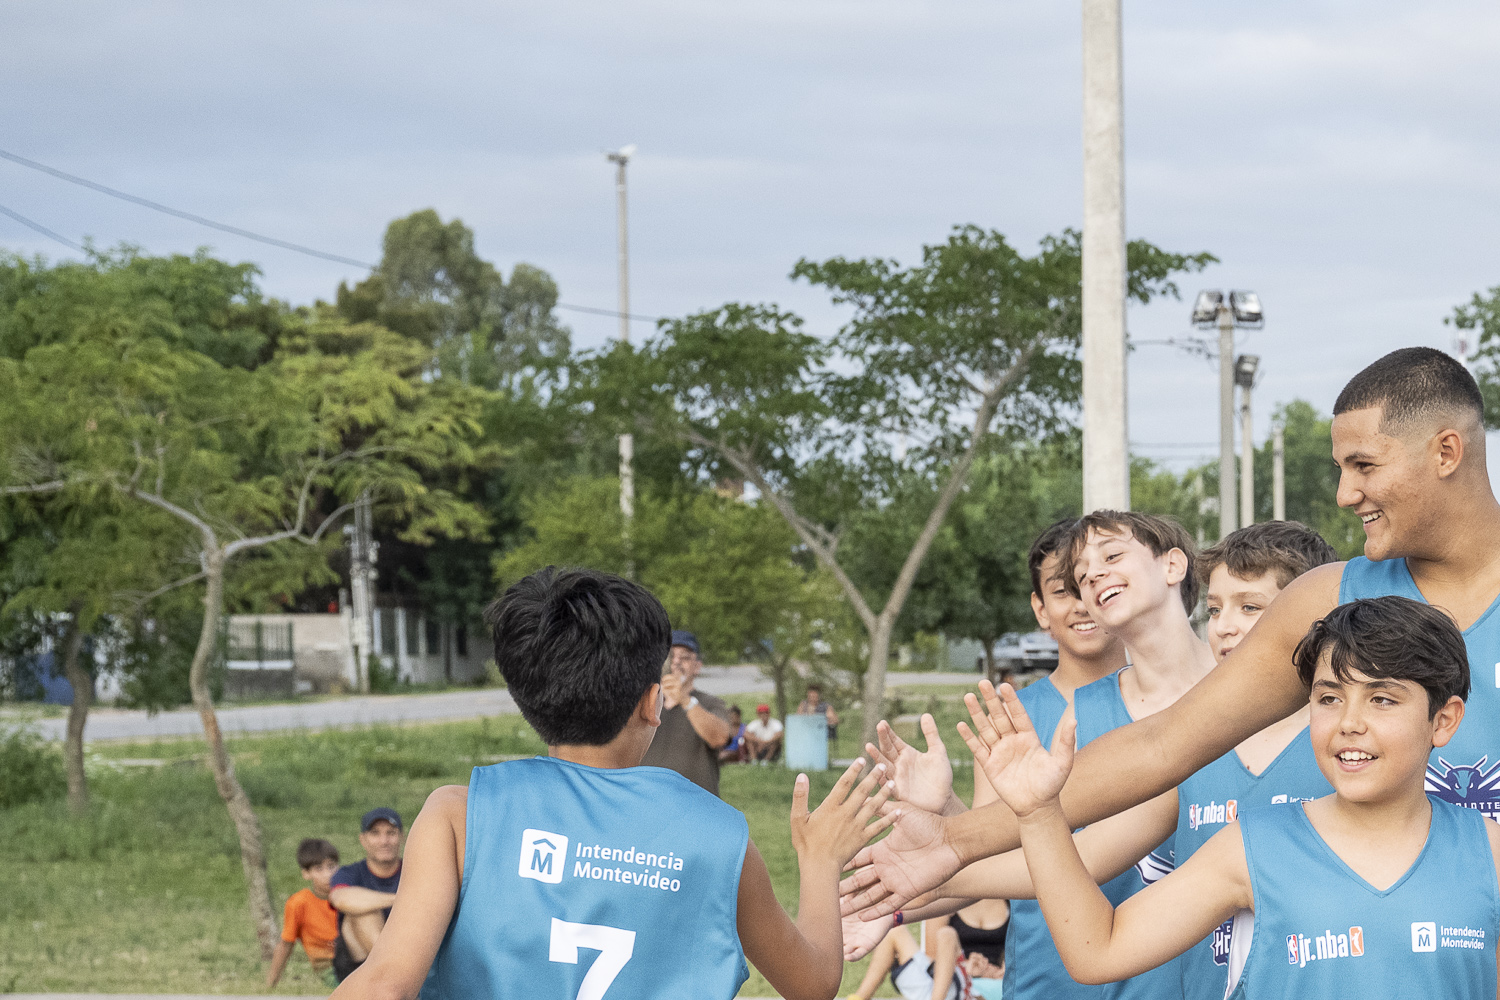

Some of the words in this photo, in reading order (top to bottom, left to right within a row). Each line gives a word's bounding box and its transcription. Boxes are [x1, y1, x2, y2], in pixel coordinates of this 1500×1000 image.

[1195, 803, 1225, 831] jr.nba
[575, 842, 684, 871] Intendencia
[573, 861, 681, 892] Montevideo
[1440, 925, 1485, 938] Intendencia
[1440, 936, 1485, 950] Montevideo
[1298, 929, 1349, 968] jr.nba
